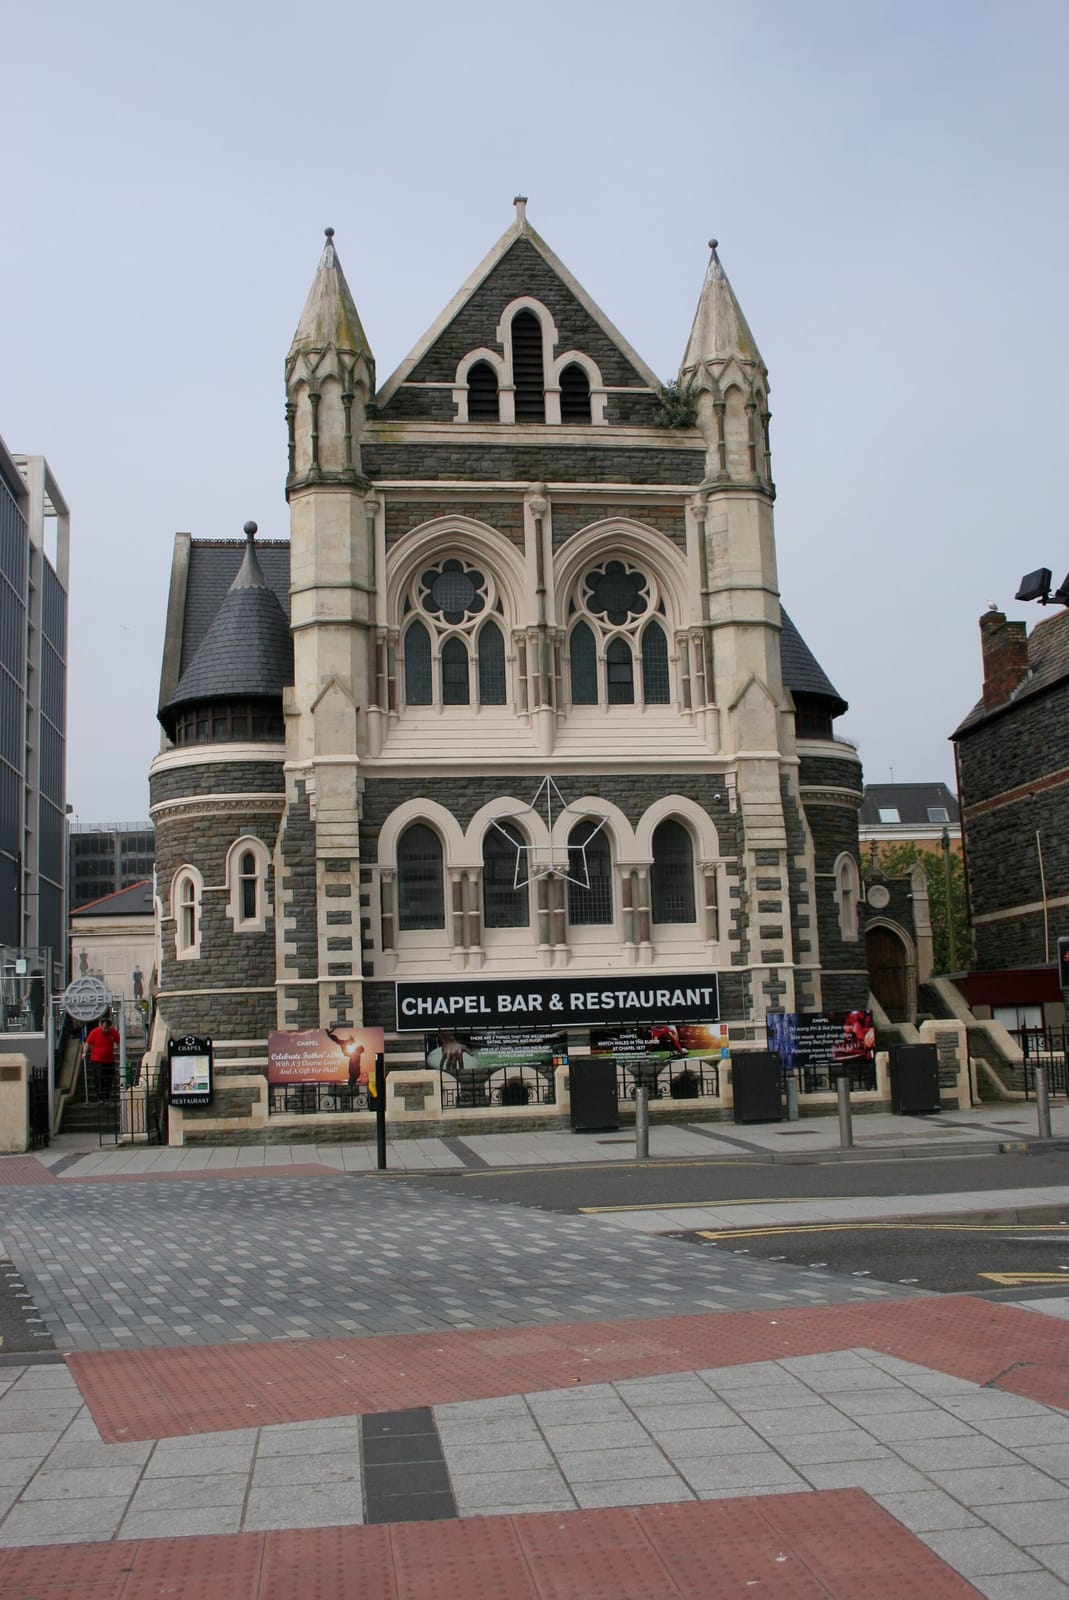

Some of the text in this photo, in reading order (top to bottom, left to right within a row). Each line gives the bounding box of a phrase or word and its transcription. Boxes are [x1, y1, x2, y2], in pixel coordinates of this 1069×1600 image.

[62, 992, 112, 1005] CHAPEL
[401, 988, 713, 1016] CHAPEL BAR & RESTAURANT
[271, 1052, 301, 1060] Celebrate
[298, 1067, 310, 1075] Gift
